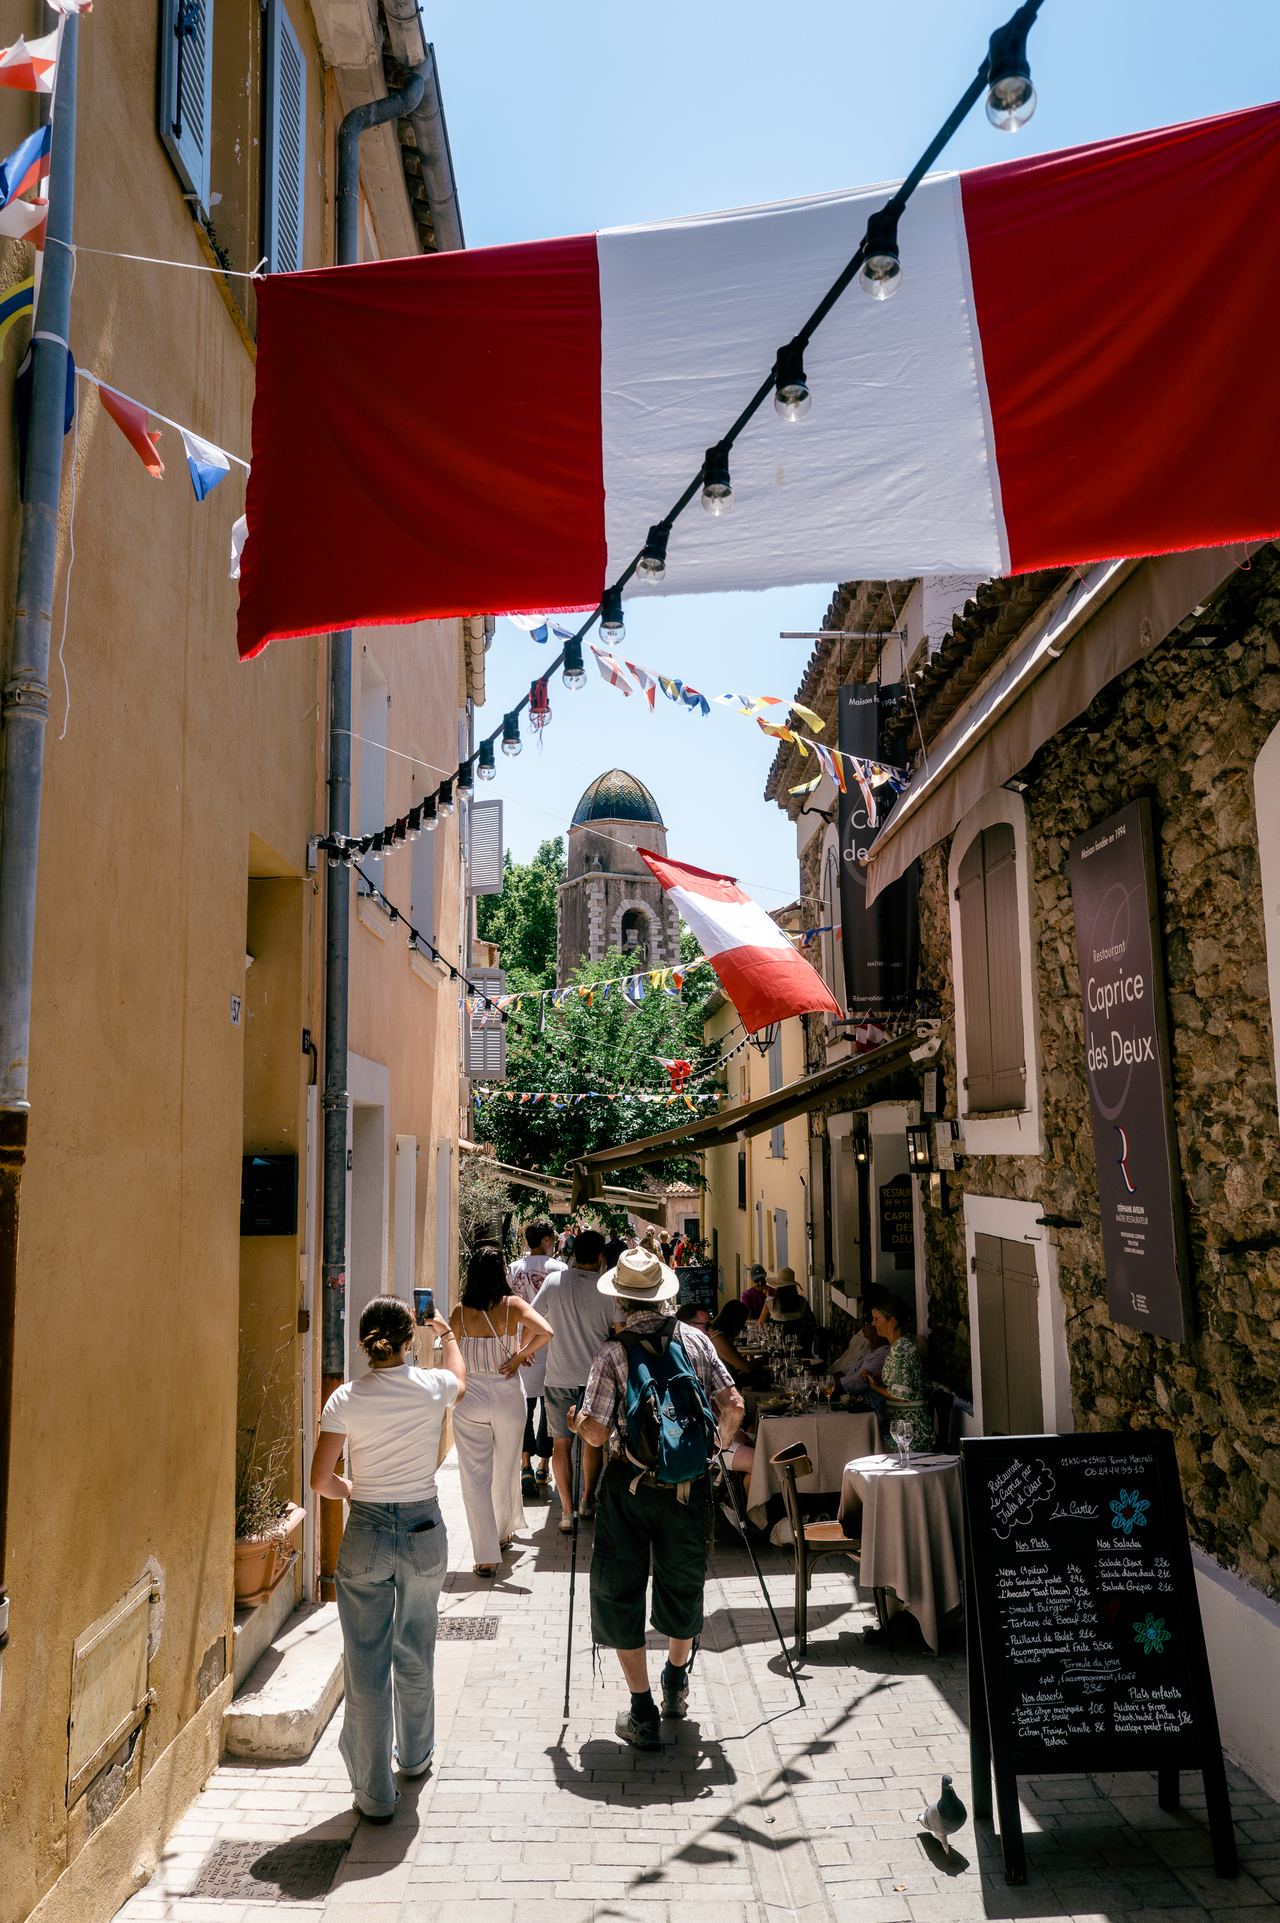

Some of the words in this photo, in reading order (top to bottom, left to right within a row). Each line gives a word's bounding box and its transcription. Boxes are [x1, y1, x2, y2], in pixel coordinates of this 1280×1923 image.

[849, 698, 873, 706] Maison
[1080, 846, 1095, 860] Maison
[1094, 836, 1109, 851] fondée
[1115, 824, 1126, 840] 1994
[843, 839, 868, 862] de
[1092, 940, 1126, 963] Restaurant
[1087, 967, 1144, 1019] Caprice
[1088, 1032, 1108, 1071] des
[1111, 1031, 1155, 1067] Deux
[881, 1188, 912, 1198] RESTAUR
[884, 1211, 913, 1221] CAPR
[892, 1234, 913, 1244] DEU
[988, 1458, 1023, 1494] Restaurant
[991, 1497, 1001, 1510] Le
[1000, 1478, 1022, 1500] Caprice
[1022, 1465, 1032, 1482] par
[1052, 1501, 1068, 1516] La
[1069, 1500, 1100, 1515] Carte
[1015, 1540, 1030, 1551] Nos
[1030, 1537, 1050, 1549] Plats
[1096, 1539, 1111, 1549] Nos
[1112, 1537, 1142, 1549] Salades
[1098, 1557, 1122, 1568] Salade
[998, 1567, 1017, 1577] Nems
[1100, 1569, 1121, 1579] Salade
[999, 1577, 1014, 1588] Club
[1015, 1576, 1044, 1588] Sandwich
[1044, 1574, 1063, 1589] poulet
[1101, 1580, 1126, 1592] Salade
[1030, 1587, 1050, 1598] Toast
[1008, 1602, 1036, 1615] Smash
[1036, 1601, 1071, 1617] Burger
[1008, 1617, 1041, 1629] Tartare
[1042, 1616, 1054, 1627] de
[1042, 1632, 1054, 1643] de
[1054, 1630, 1075, 1642] Poulet
[1013, 1656, 1042, 1665] Salade
[1060, 1657, 1092, 1670] Formule
[1092, 1657, 1104, 1667] du
[1103, 1657, 1122, 1671] jour
[1021, 1692, 1036, 1704] Nos
[1036, 1689, 1064, 1702] desserts
[1128, 1686, 1150, 1700] Plats
[1151, 1684, 1182, 1700] enfants
[1087, 1700, 1106, 1715] 10€
[1147, 1702, 1167, 1714] Sirop
[1113, 1712, 1136, 1723] Steak
[1066, 1721, 1092, 1734] Vanille
